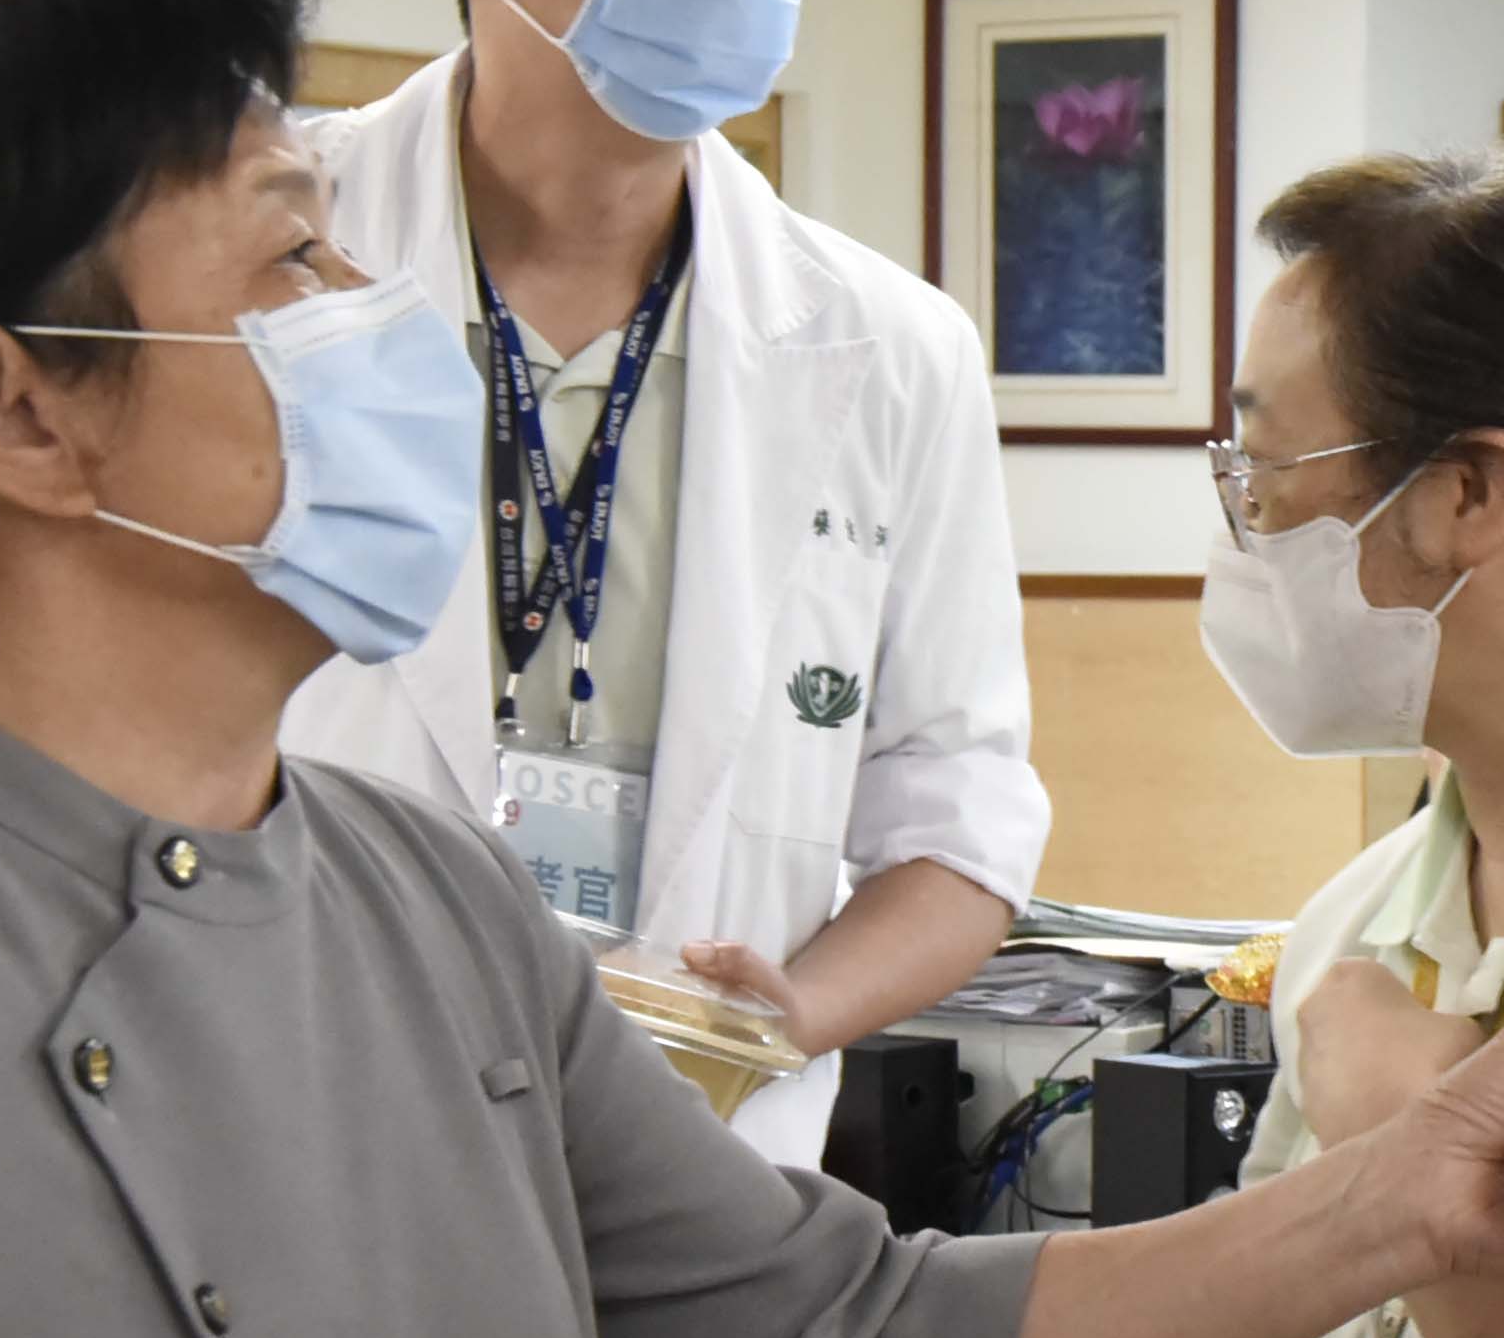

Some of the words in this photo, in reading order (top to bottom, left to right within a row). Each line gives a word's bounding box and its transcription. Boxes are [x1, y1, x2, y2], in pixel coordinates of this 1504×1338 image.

[605, 412, 625, 447] ENJOY
[590, 500, 609, 541] ENJOY
[514, 764, 639, 817] OSCE
[525, 854, 617, 921] 考官
